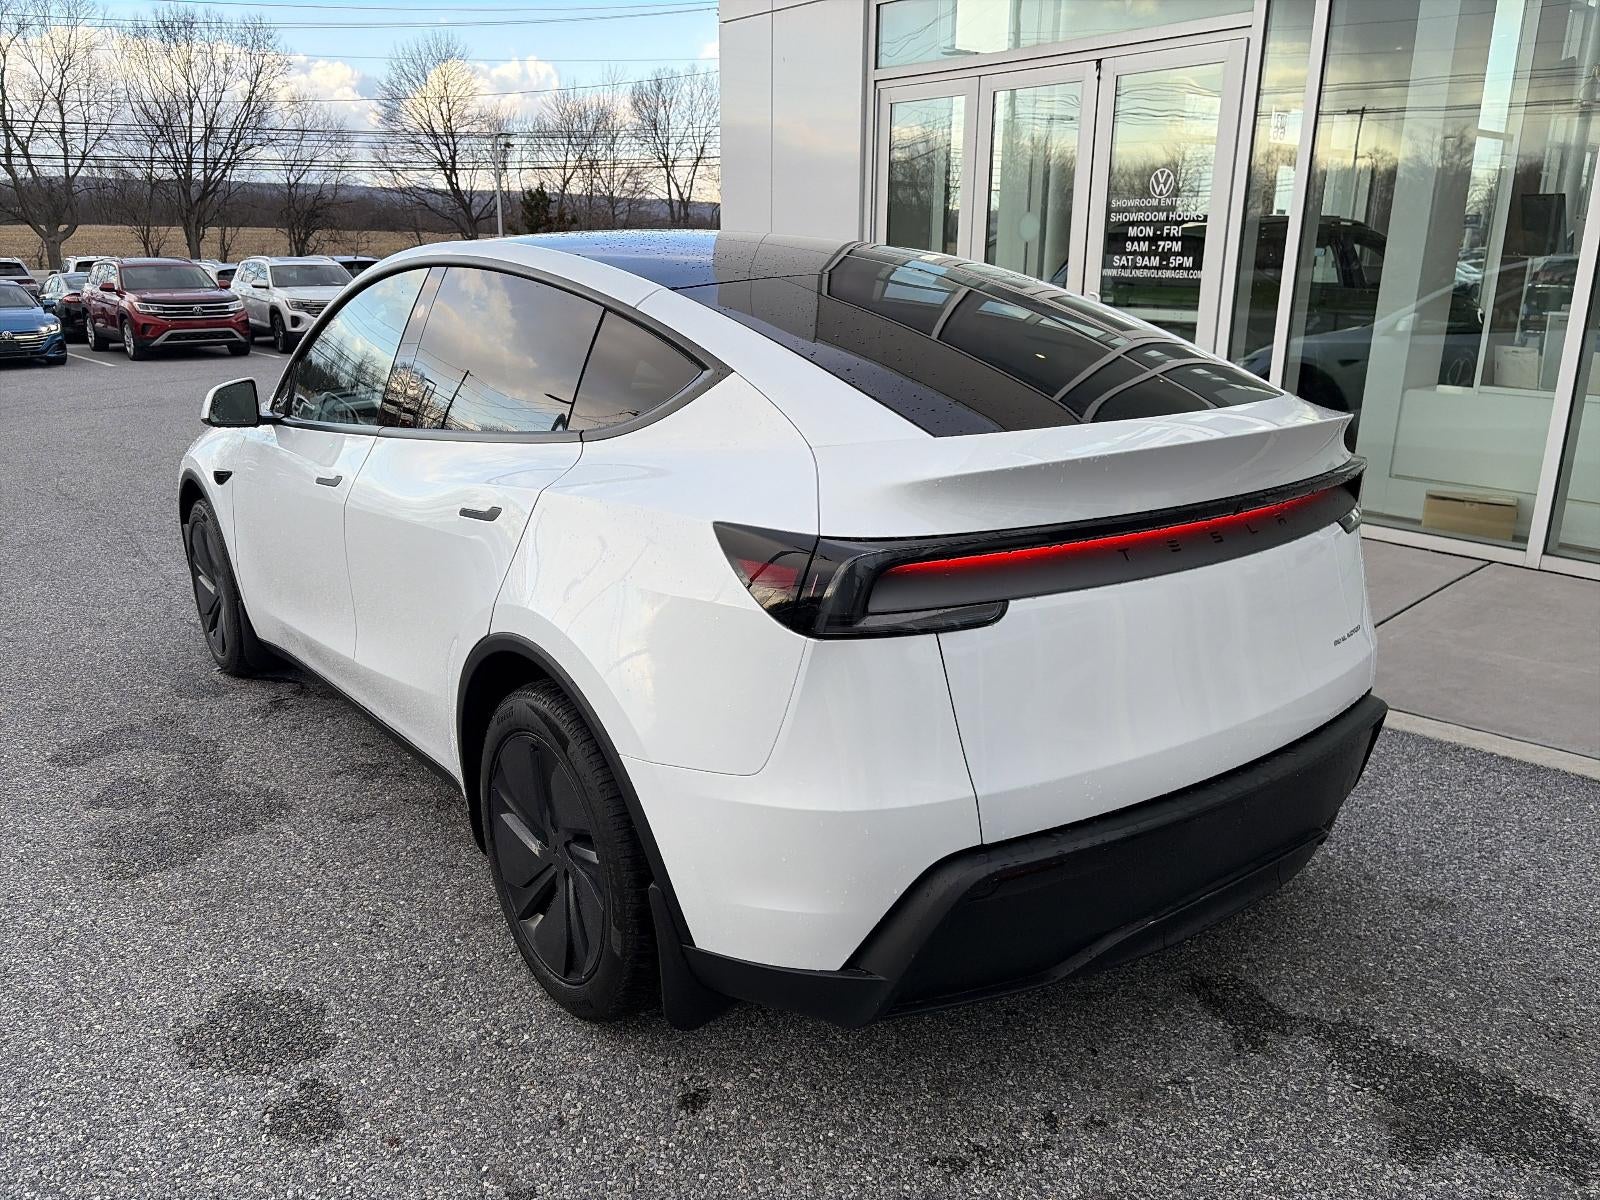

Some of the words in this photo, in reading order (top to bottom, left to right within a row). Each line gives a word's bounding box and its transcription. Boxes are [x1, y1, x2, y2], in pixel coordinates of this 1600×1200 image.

[1149, 168, 1174, 198] VW
[1111, 198, 1159, 207] SHOWROOM
[1160, 197, 1204, 206] ENTRAN
[1110, 212, 1167, 222] SHOWROOM
[1168, 211, 1205, 221] HOURS
[1127, 226, 1154, 237] MON
[1163, 226, 1182, 237] FRI
[1125, 241, 1149, 252] 9AM
[1157, 241, 1182, 252] 7PM
[1112, 255, 1134, 267] SAT
[1136, 256, 1160, 267] 9AM
[1169, 256, 1193, 268] 5PM
[1117, 512, 1288, 562] TESLA
